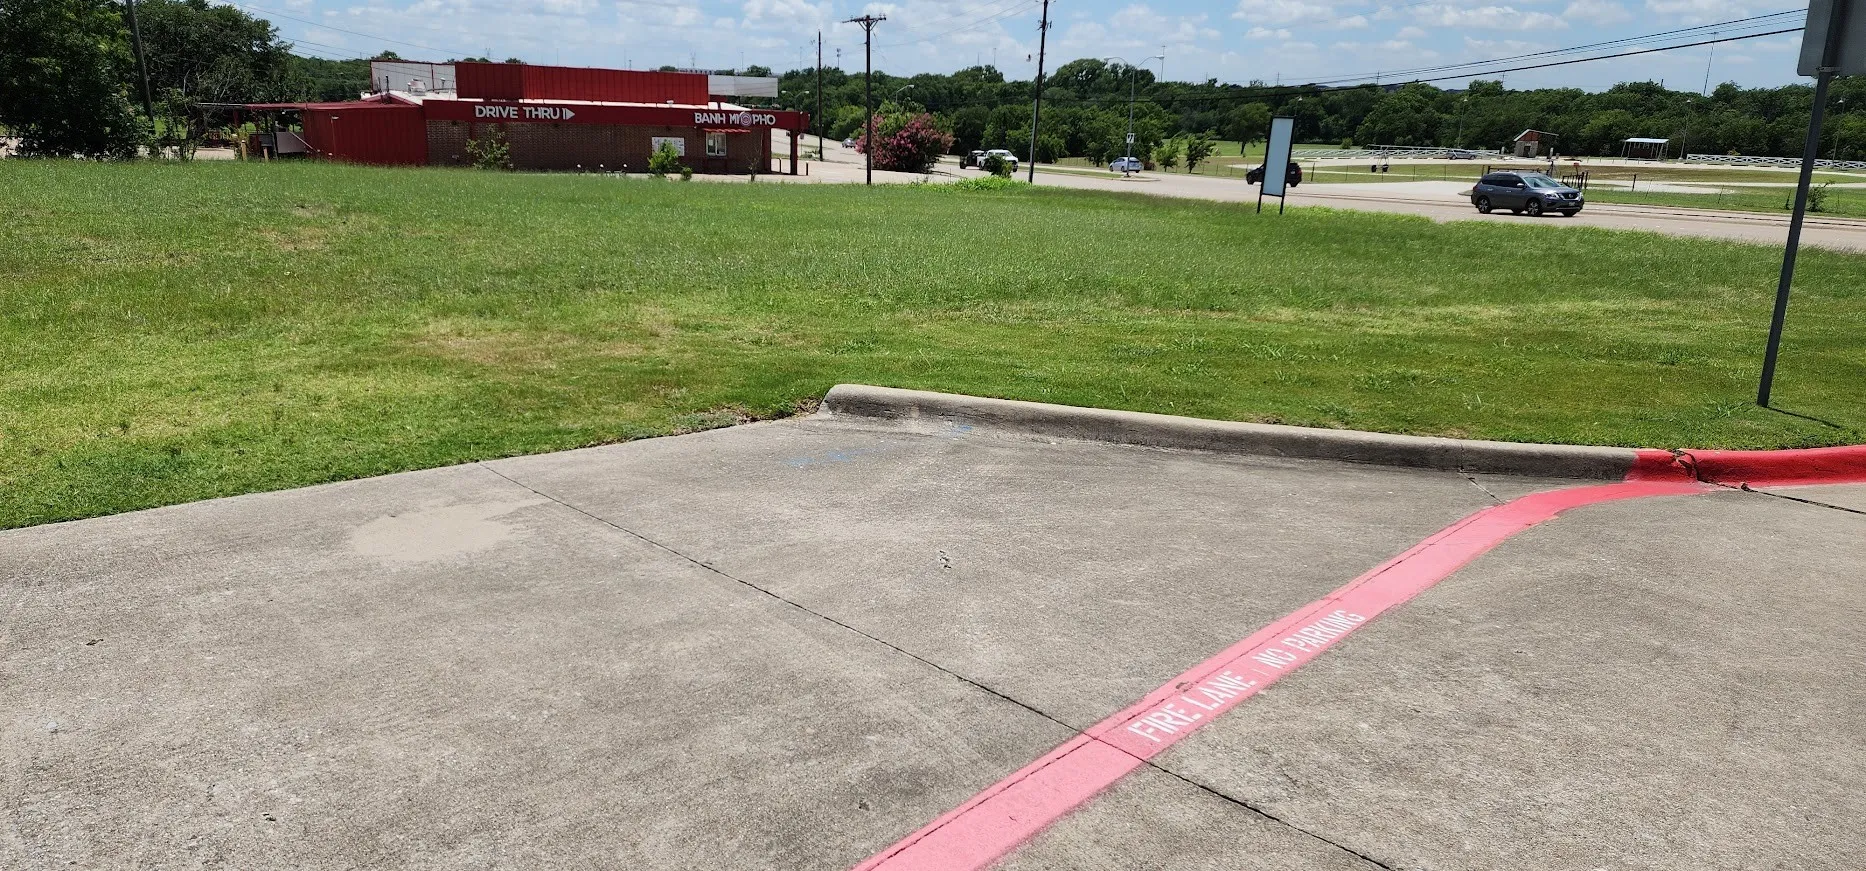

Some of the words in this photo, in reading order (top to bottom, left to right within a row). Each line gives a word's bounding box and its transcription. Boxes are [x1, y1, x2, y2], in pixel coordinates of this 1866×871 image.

[475, 105, 518, 118] DRIVE
[523, 106, 560, 119] THRU
[694, 112, 726, 124] BANH
[752, 114, 776, 125] PHO
[1128, 703, 1201, 742] FIRE
[1180, 670, 1256, 711] LANE
[1252, 648, 1297, 669] NO
[1281, 610, 1366, 653] PARKING
